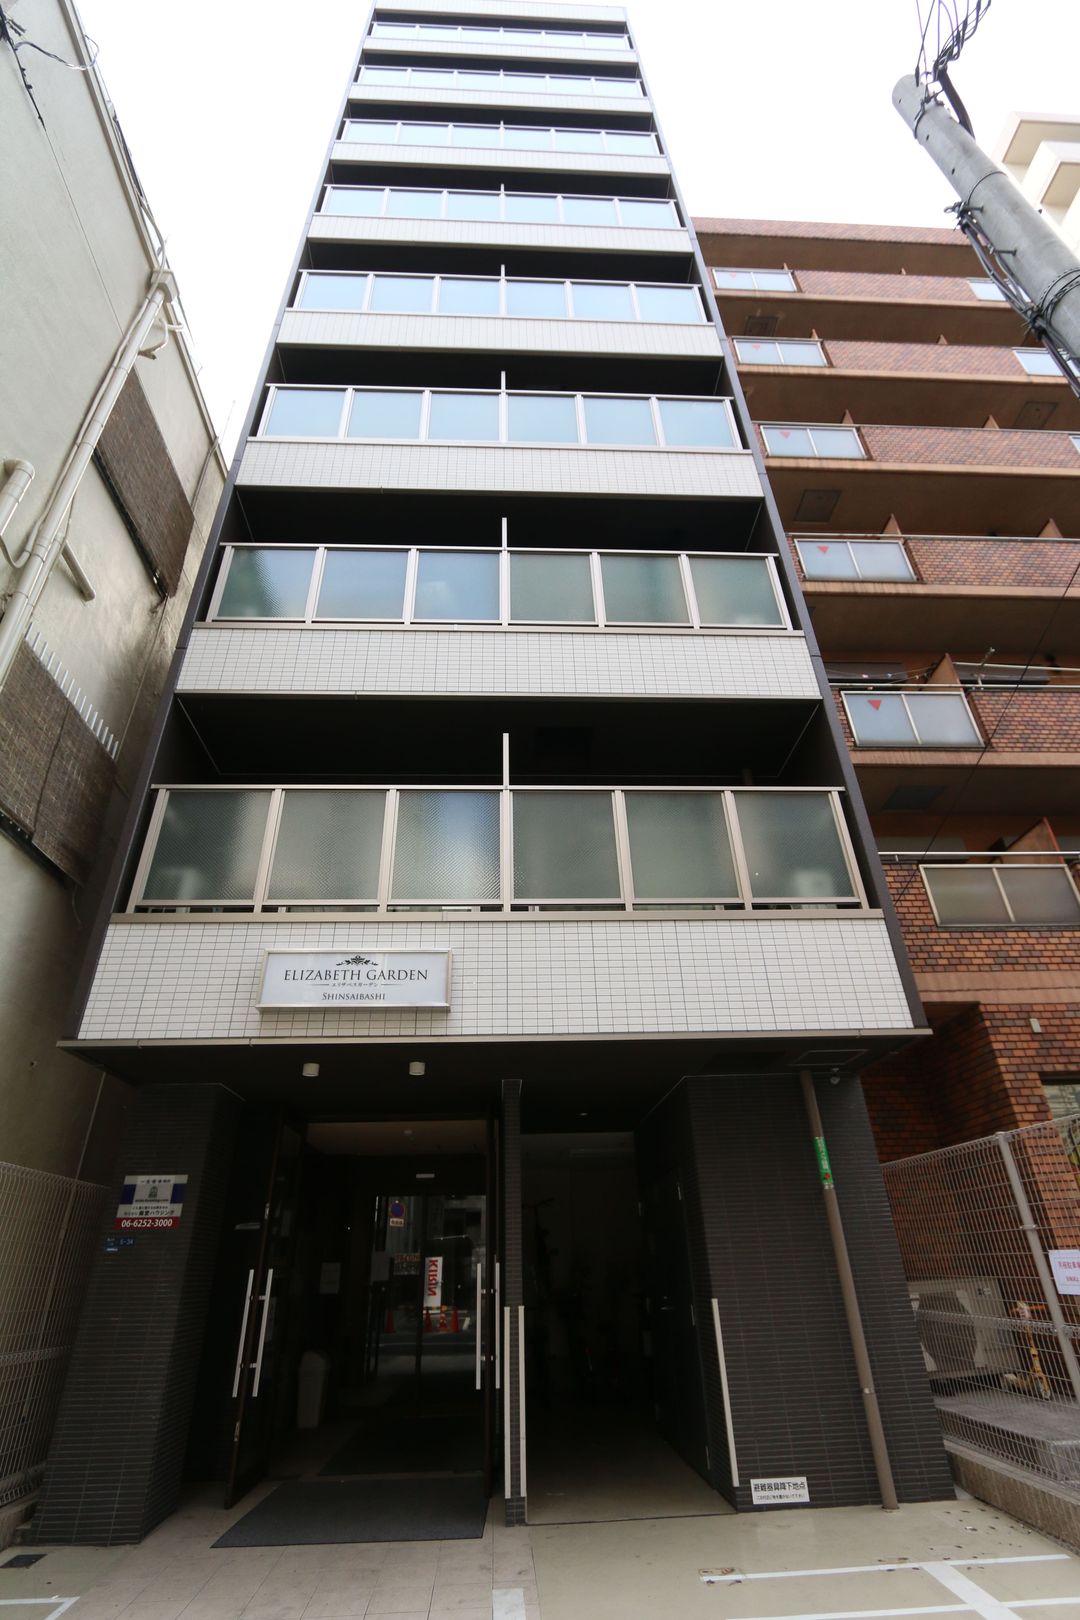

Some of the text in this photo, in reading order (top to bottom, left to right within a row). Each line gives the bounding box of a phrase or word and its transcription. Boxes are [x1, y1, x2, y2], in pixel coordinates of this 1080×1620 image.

[284, 969, 428, 981] ELIZABETH GARDEN
[322, 992, 386, 1001] SHINSAIBASHI
[121, 1218, 173, 1228] 06-6252-3000
